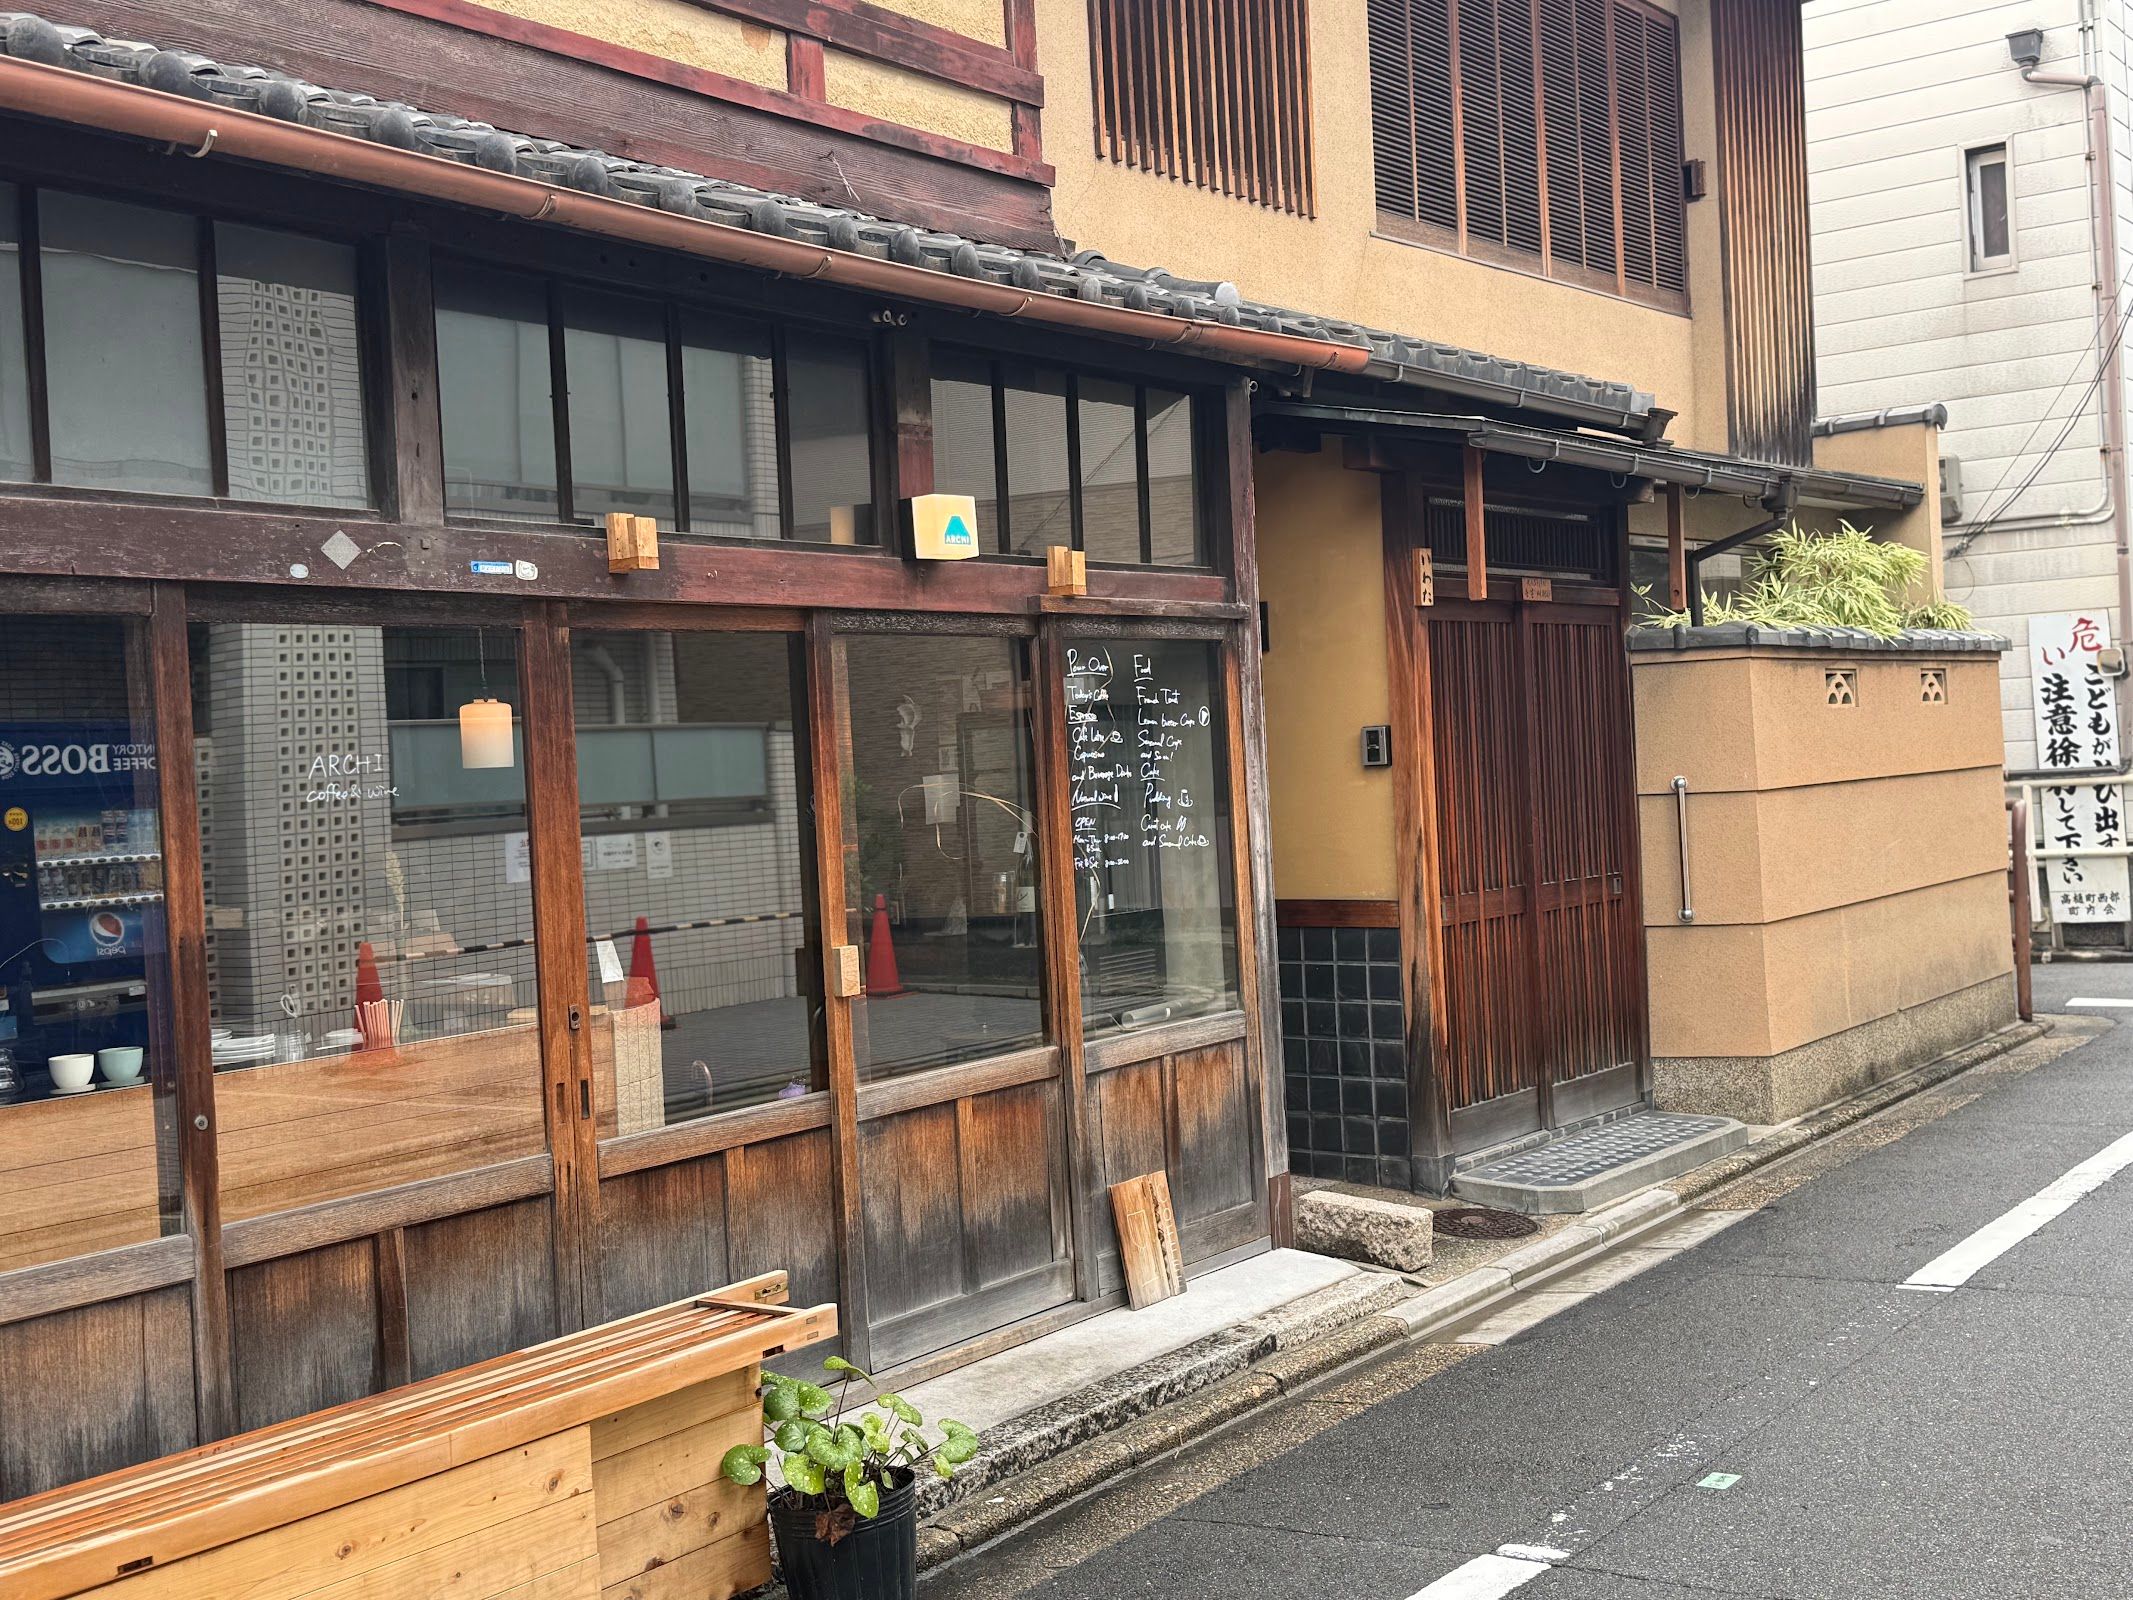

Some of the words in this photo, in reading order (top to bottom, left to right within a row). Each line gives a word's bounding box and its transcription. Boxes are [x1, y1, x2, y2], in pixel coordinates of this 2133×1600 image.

[945, 534, 970, 544] ARCHI
[1088, 656, 1109, 672] Over
[308, 753, 385, 780] ARCHI
[367, 785, 400, 799] wine
[1075, 817, 1097, 829] OPEN
[2068, 903, 2116, 916] 町内会
